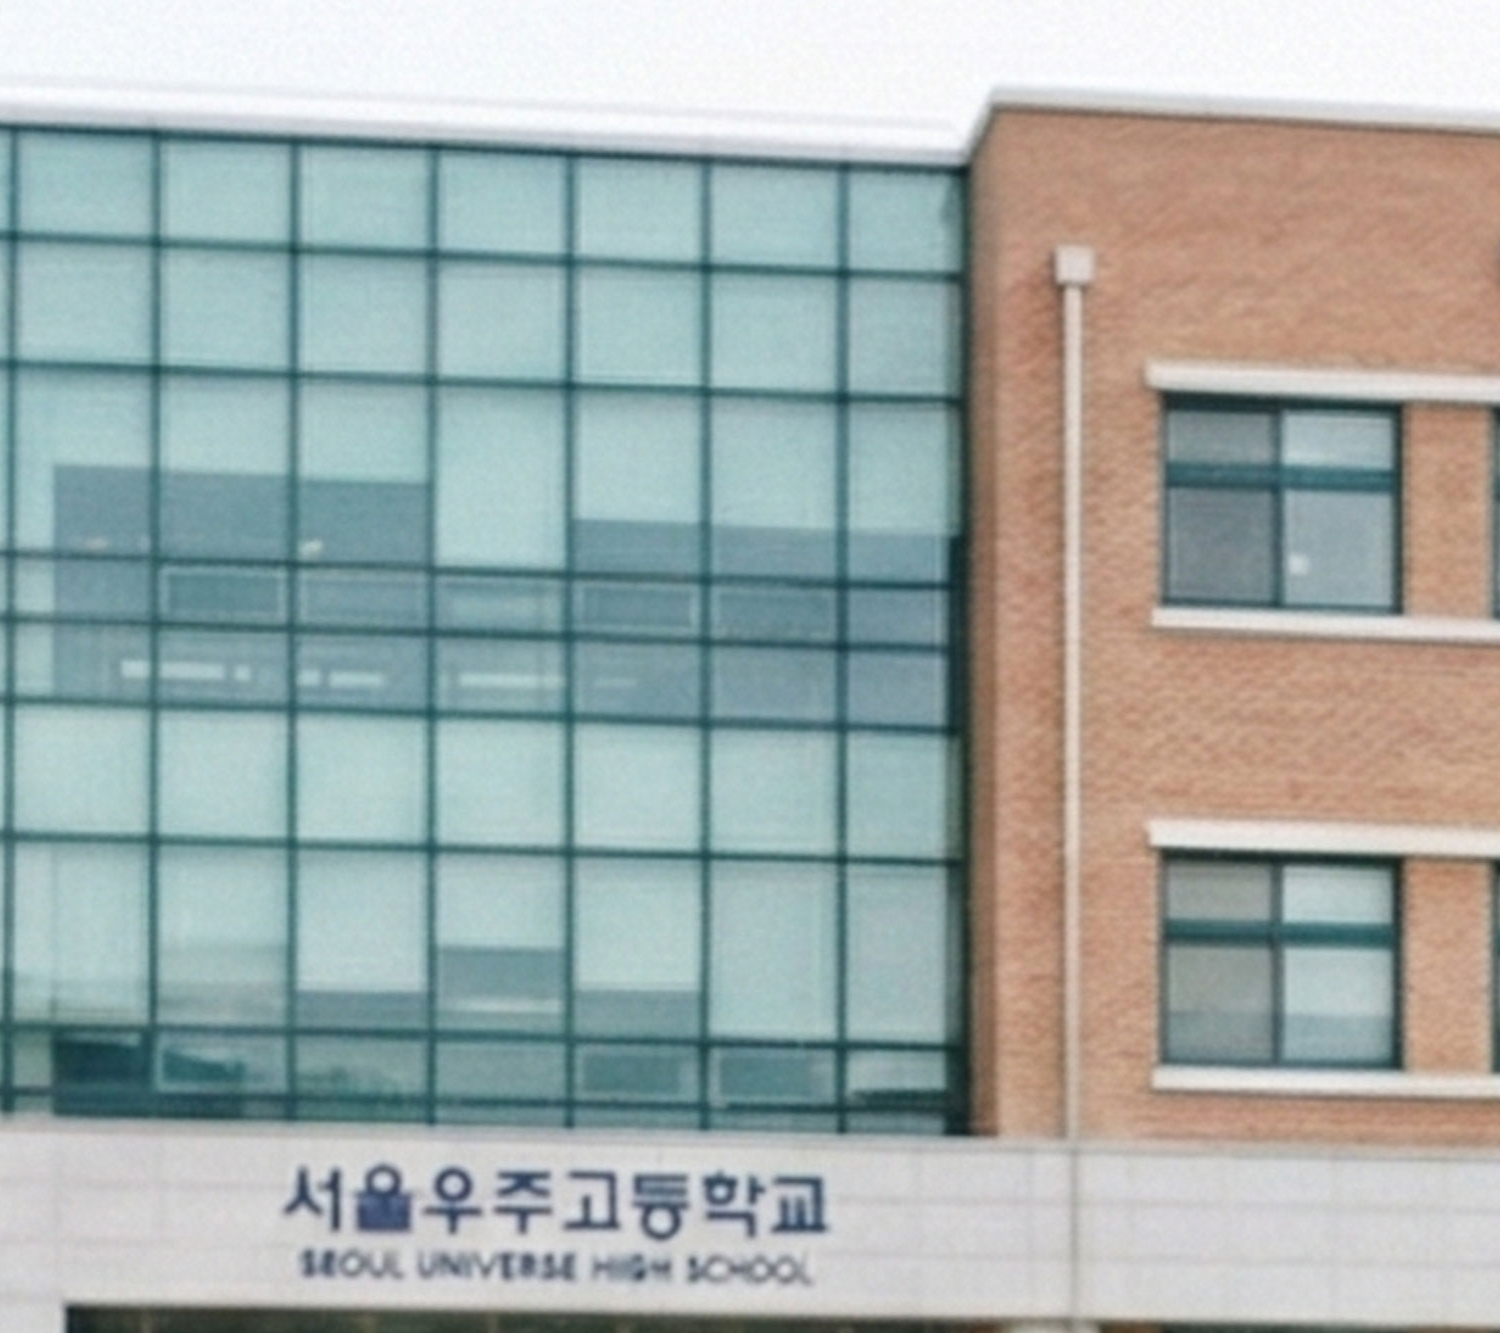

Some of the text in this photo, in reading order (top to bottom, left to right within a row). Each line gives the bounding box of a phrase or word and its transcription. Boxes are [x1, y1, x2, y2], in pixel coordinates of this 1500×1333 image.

[300, 1248, 404, 1280] SEOUL
[417, 1250, 576, 1282] UNIVERSE
[687, 1254, 814, 1286] SCHOOL
